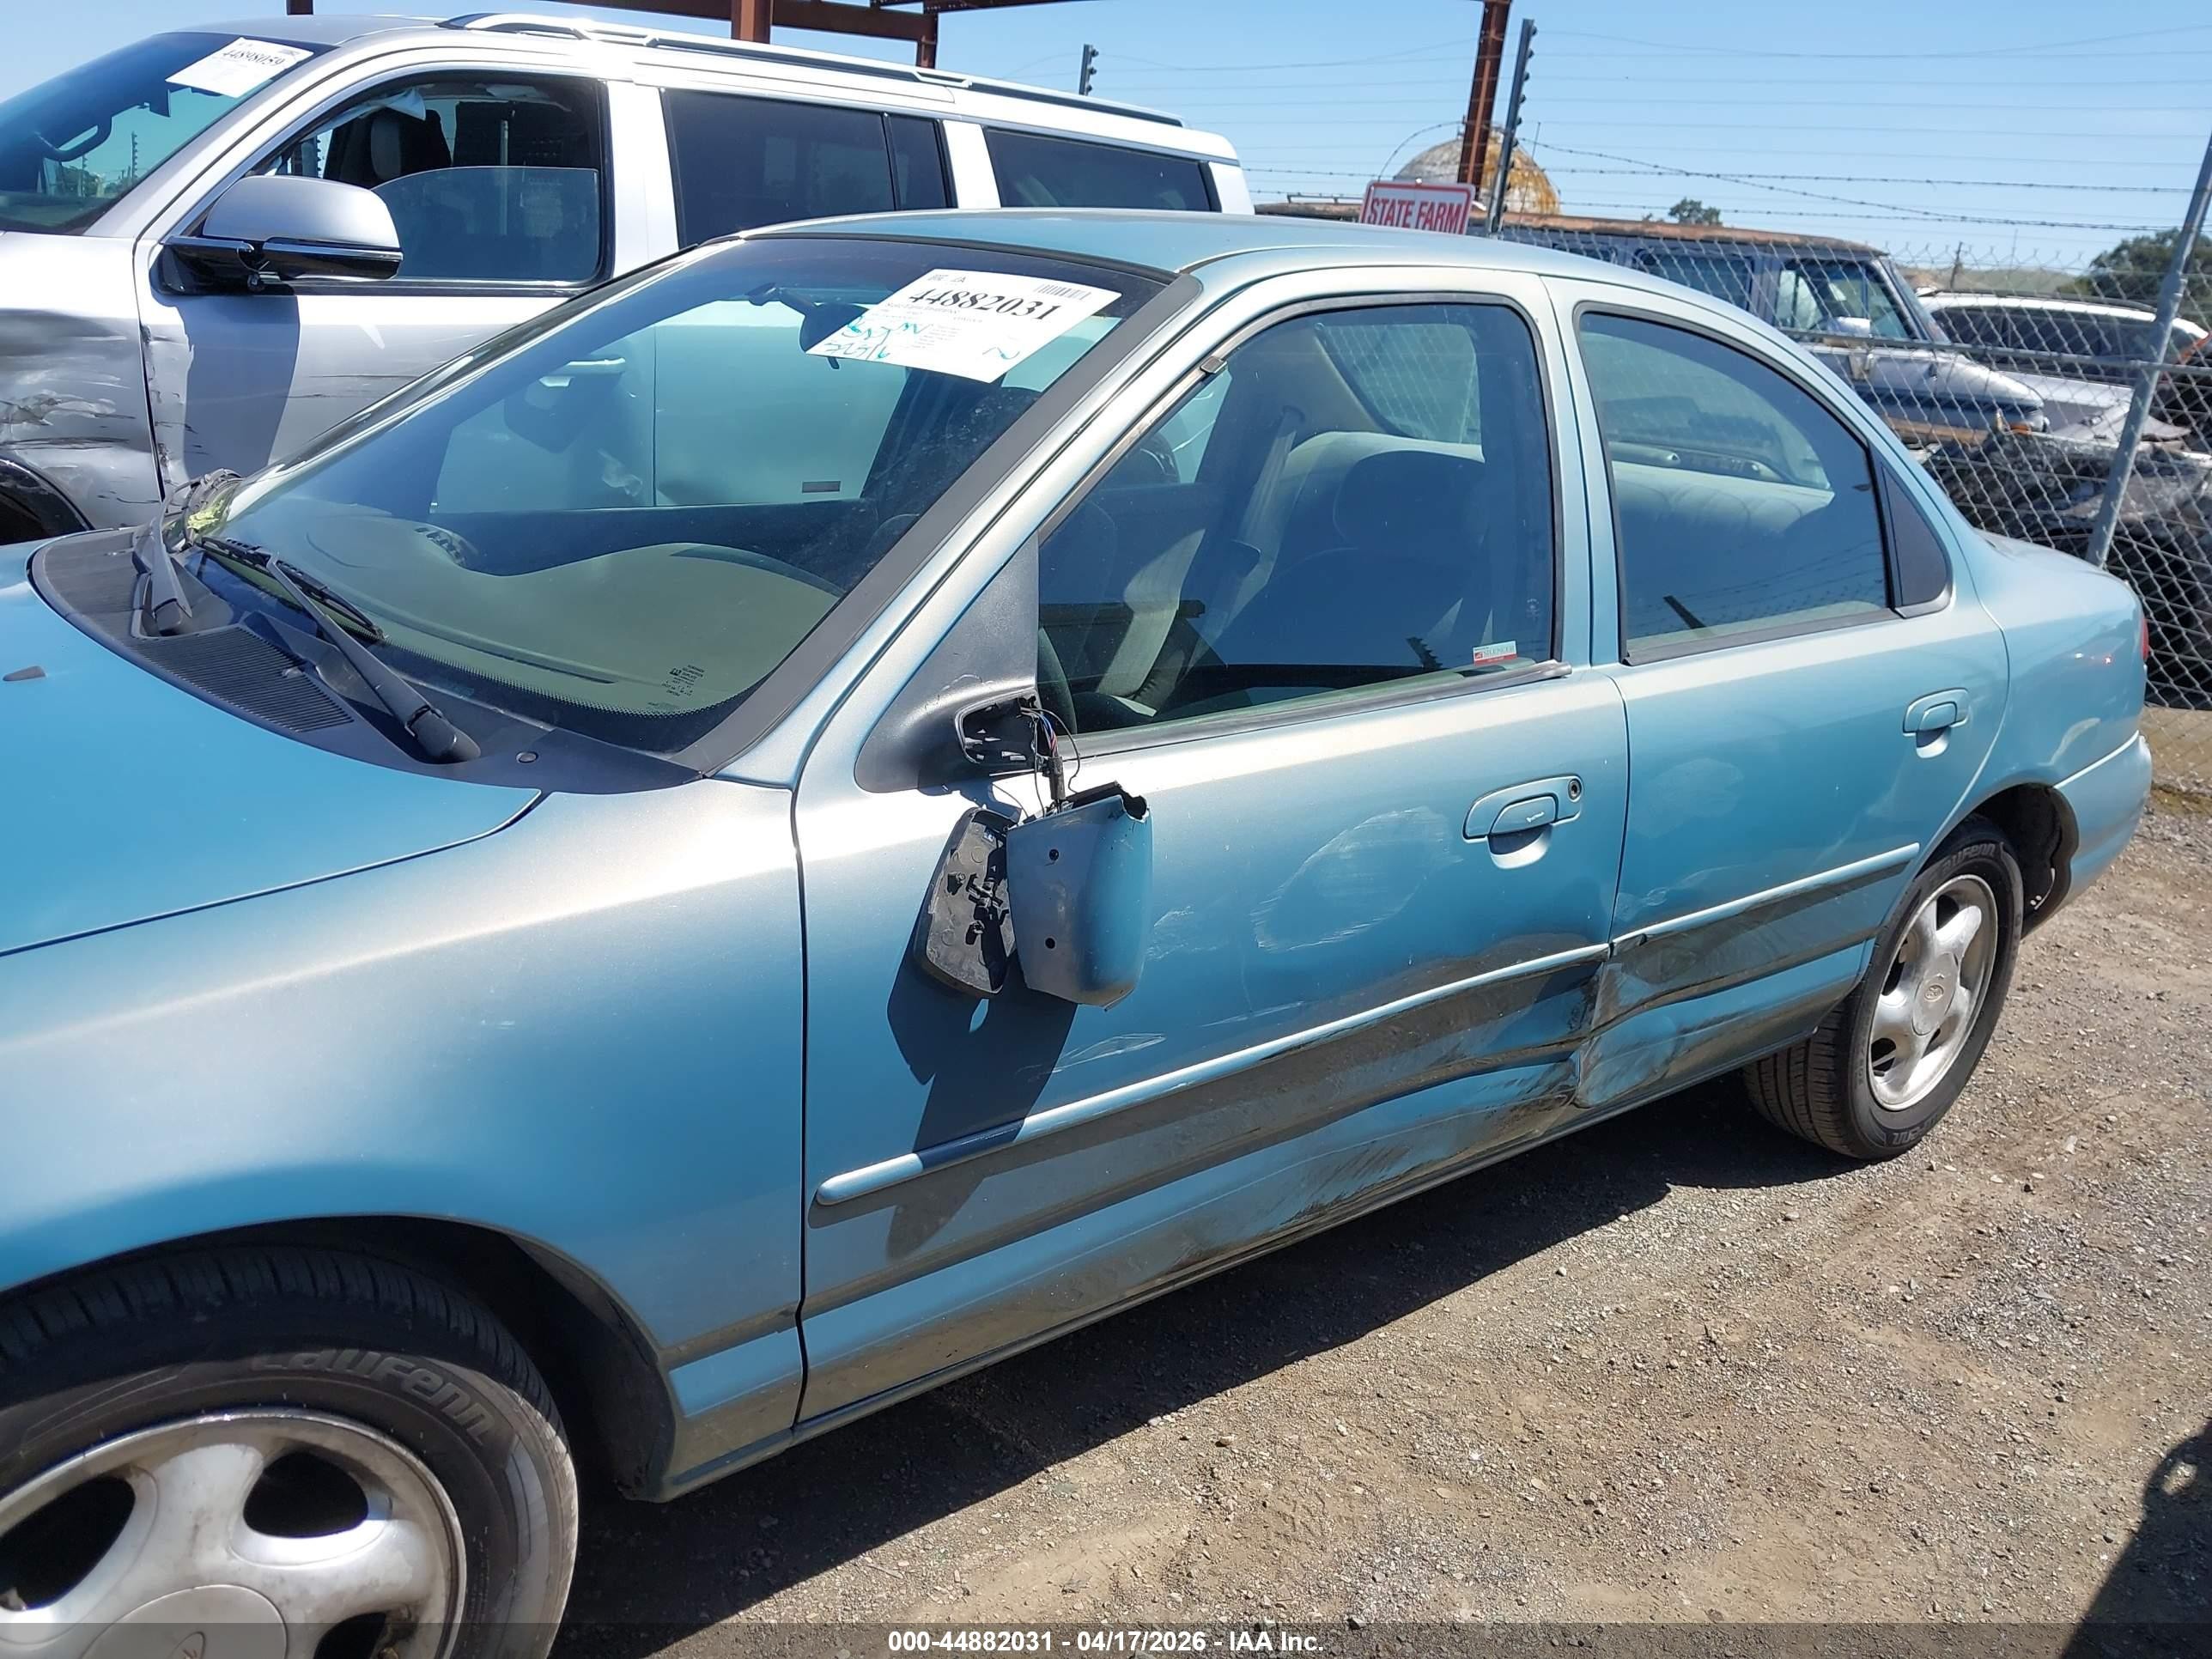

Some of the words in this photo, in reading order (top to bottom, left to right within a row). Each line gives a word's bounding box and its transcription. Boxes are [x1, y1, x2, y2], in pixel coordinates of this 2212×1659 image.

[222, 49, 286, 66] 44898059
[1369, 198, 1415, 229] STATE
[1415, 200, 1463, 234] FARM
[908, 289, 1061, 319] 44882031
